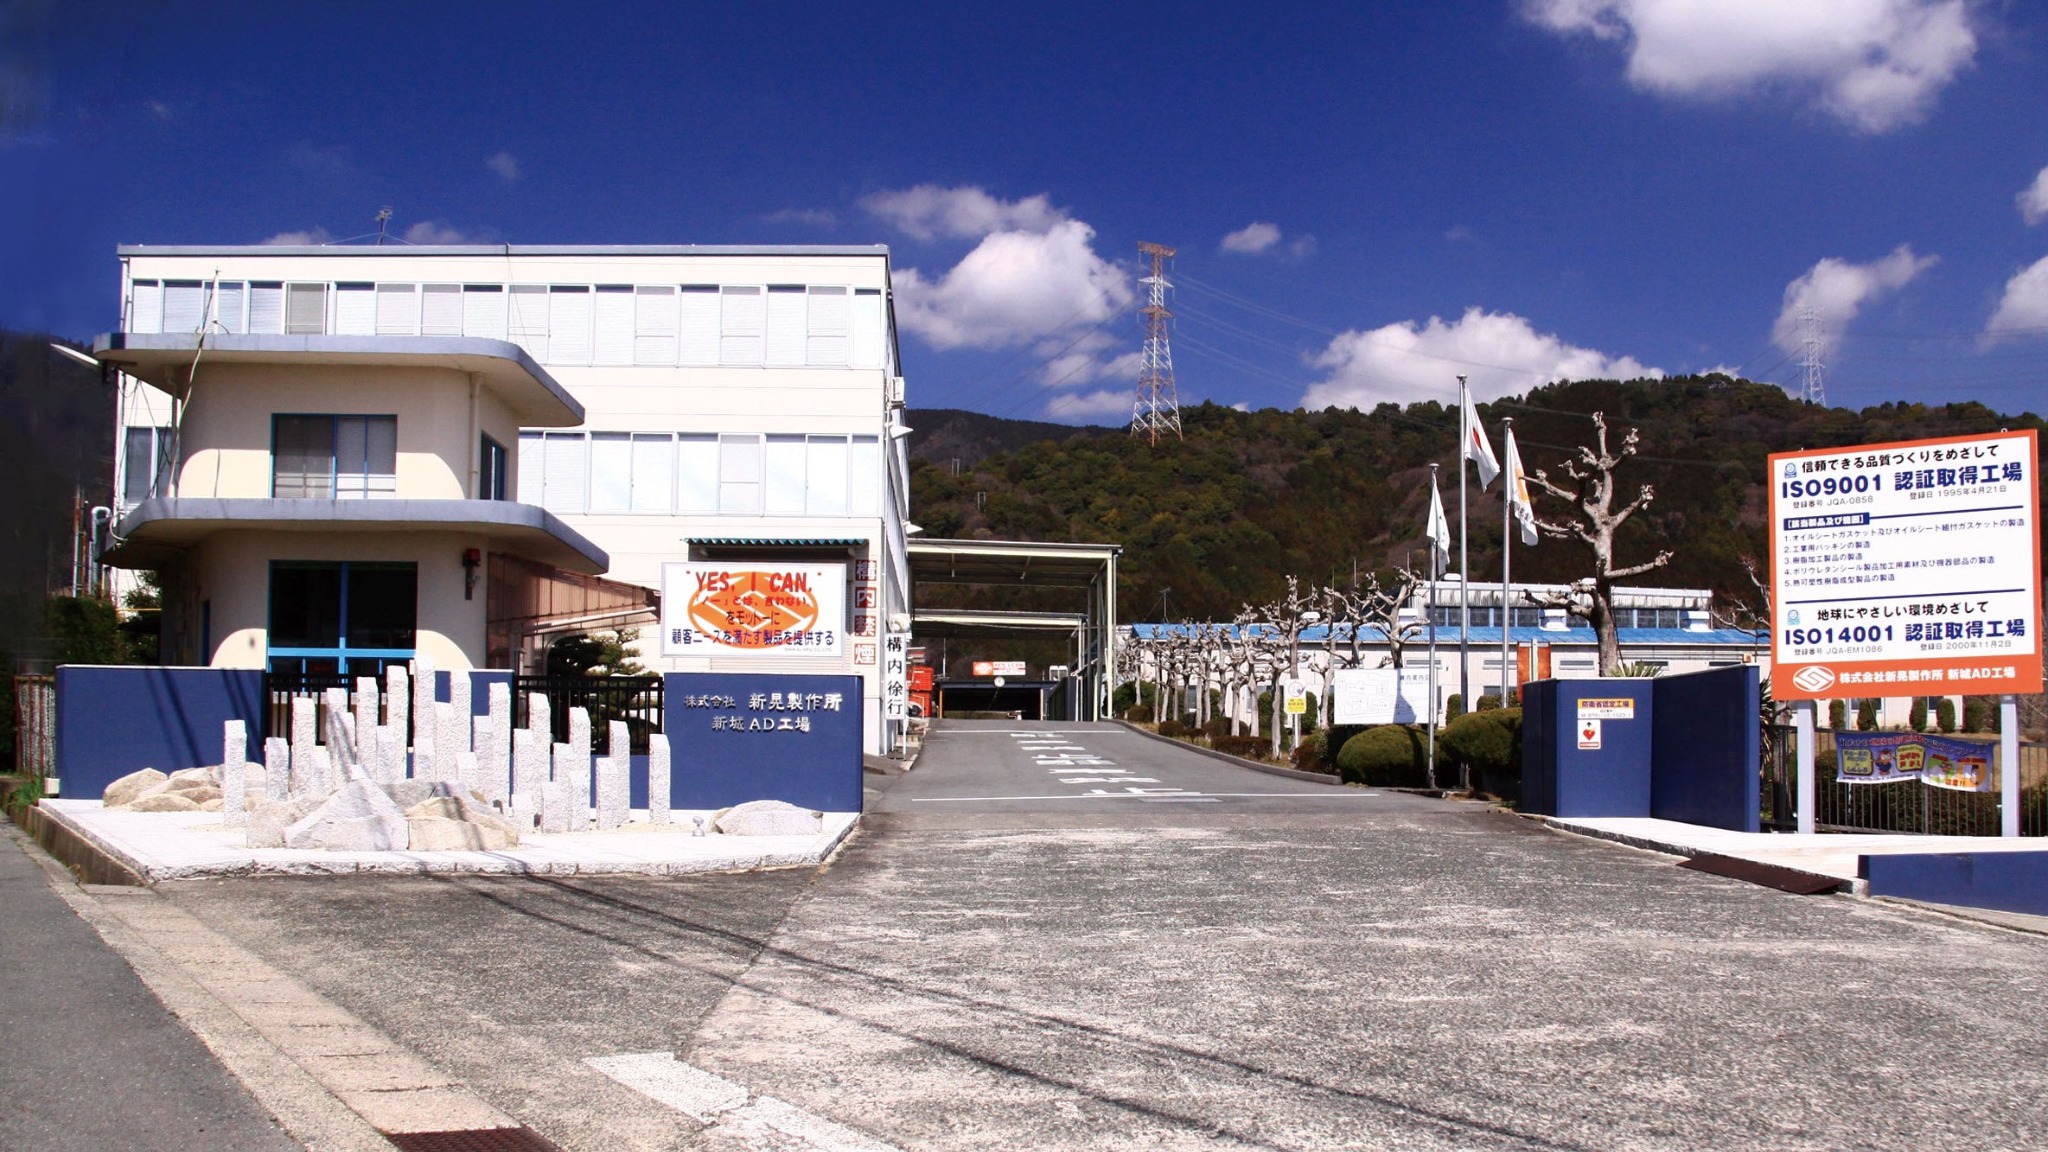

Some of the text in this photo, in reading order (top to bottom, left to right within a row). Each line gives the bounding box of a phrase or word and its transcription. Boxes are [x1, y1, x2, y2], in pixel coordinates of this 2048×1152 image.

[1802, 445, 1999, 473] 信頼できる品質づくりをめざして
[1782, 462, 2022, 498] ISO9001 認証取得工場
[1827, 496, 1874, 506] JQA-0858
[1938, 485, 2007, 497] 1995年4月21日
[751, 571, 756, 592] I
[726, 610, 780, 626] をモットーに
[1817, 601, 1988, 620] 地球にやさしい環境めざして
[1785, 619, 2025, 645] ISO14001 認証取得工場
[887, 636, 903, 715] 構内徐行
[685, 693, 842, 712] 株式会社 新晃製作所
